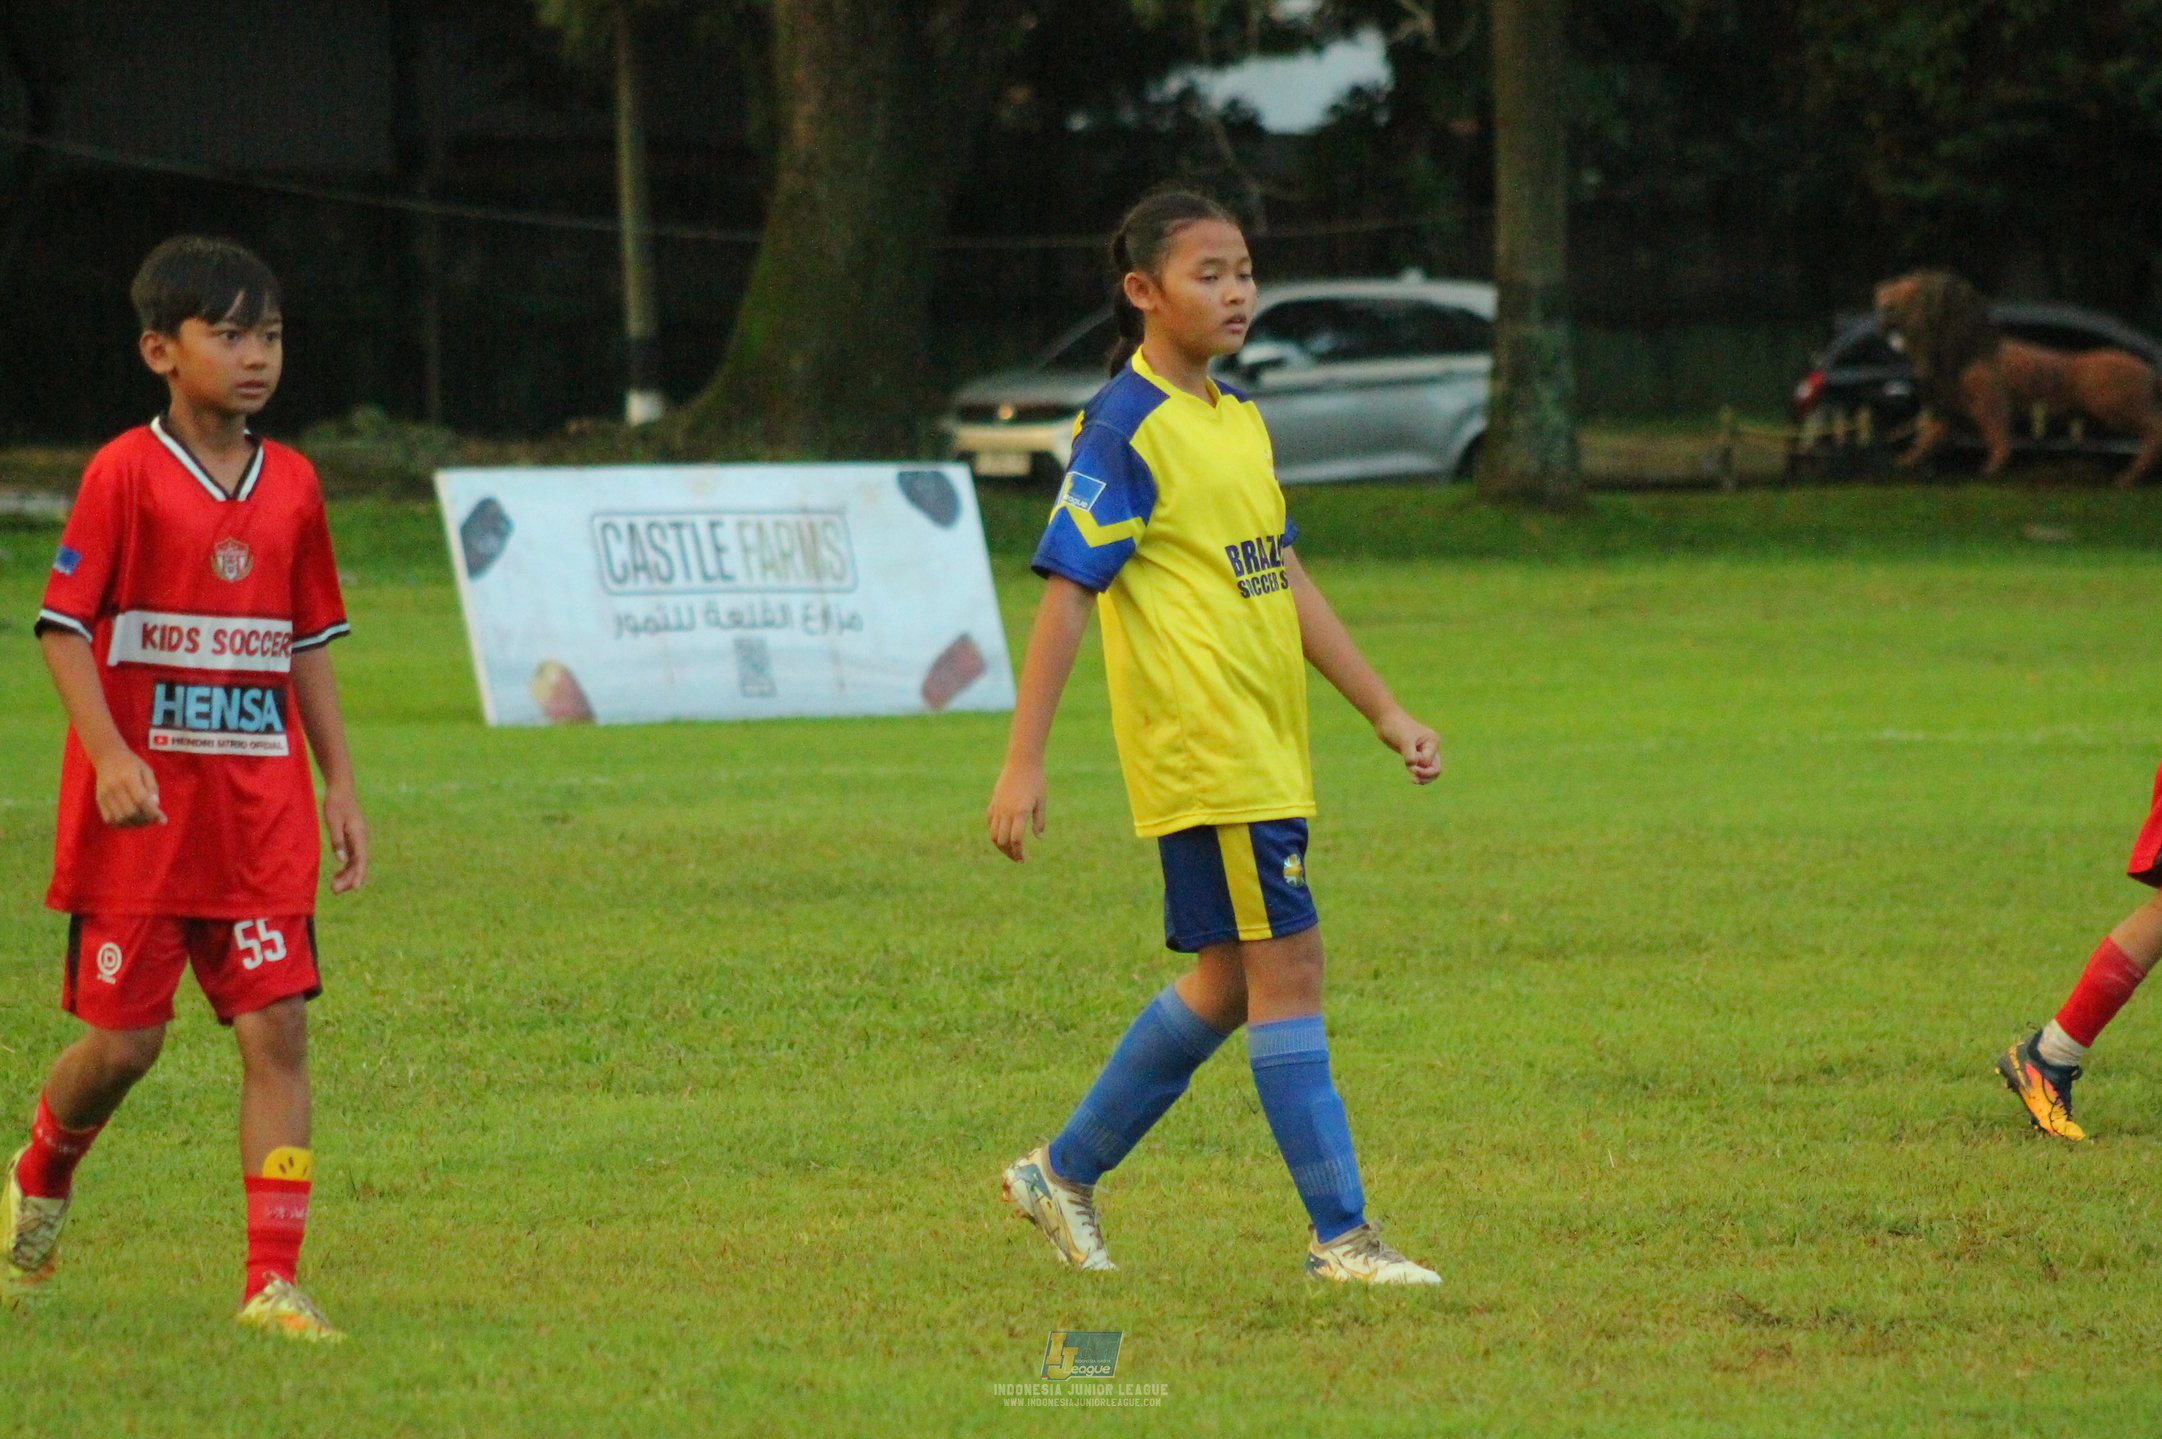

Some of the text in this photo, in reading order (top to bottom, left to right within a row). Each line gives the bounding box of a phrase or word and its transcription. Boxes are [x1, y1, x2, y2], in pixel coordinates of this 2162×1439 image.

[601, 519, 736, 585] CASTLE
[141, 622, 292, 658] KIDS SOCCER
[152, 683, 284, 732] HENSA
[233, 918, 287, 970] 55
